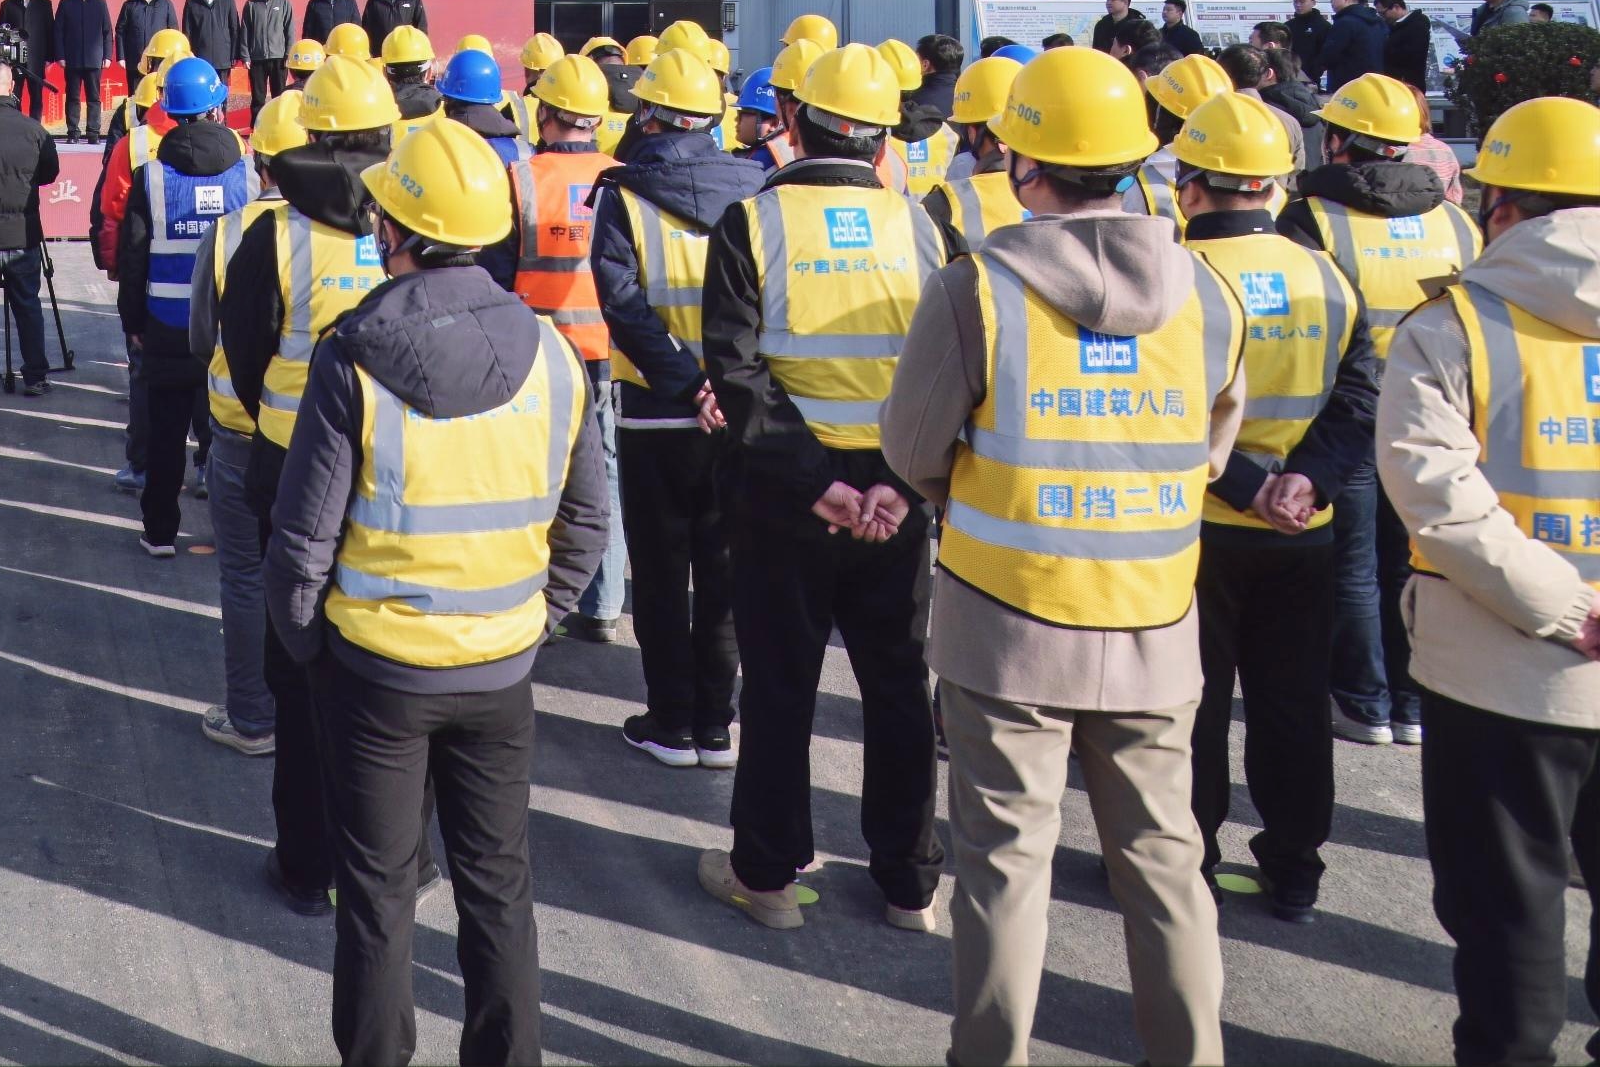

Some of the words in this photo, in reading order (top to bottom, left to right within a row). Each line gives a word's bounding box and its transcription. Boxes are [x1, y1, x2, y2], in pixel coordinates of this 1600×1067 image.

[1029, 387, 1185, 418] 中国建筑八局
[1037, 481, 1188, 519] 围挡二队
